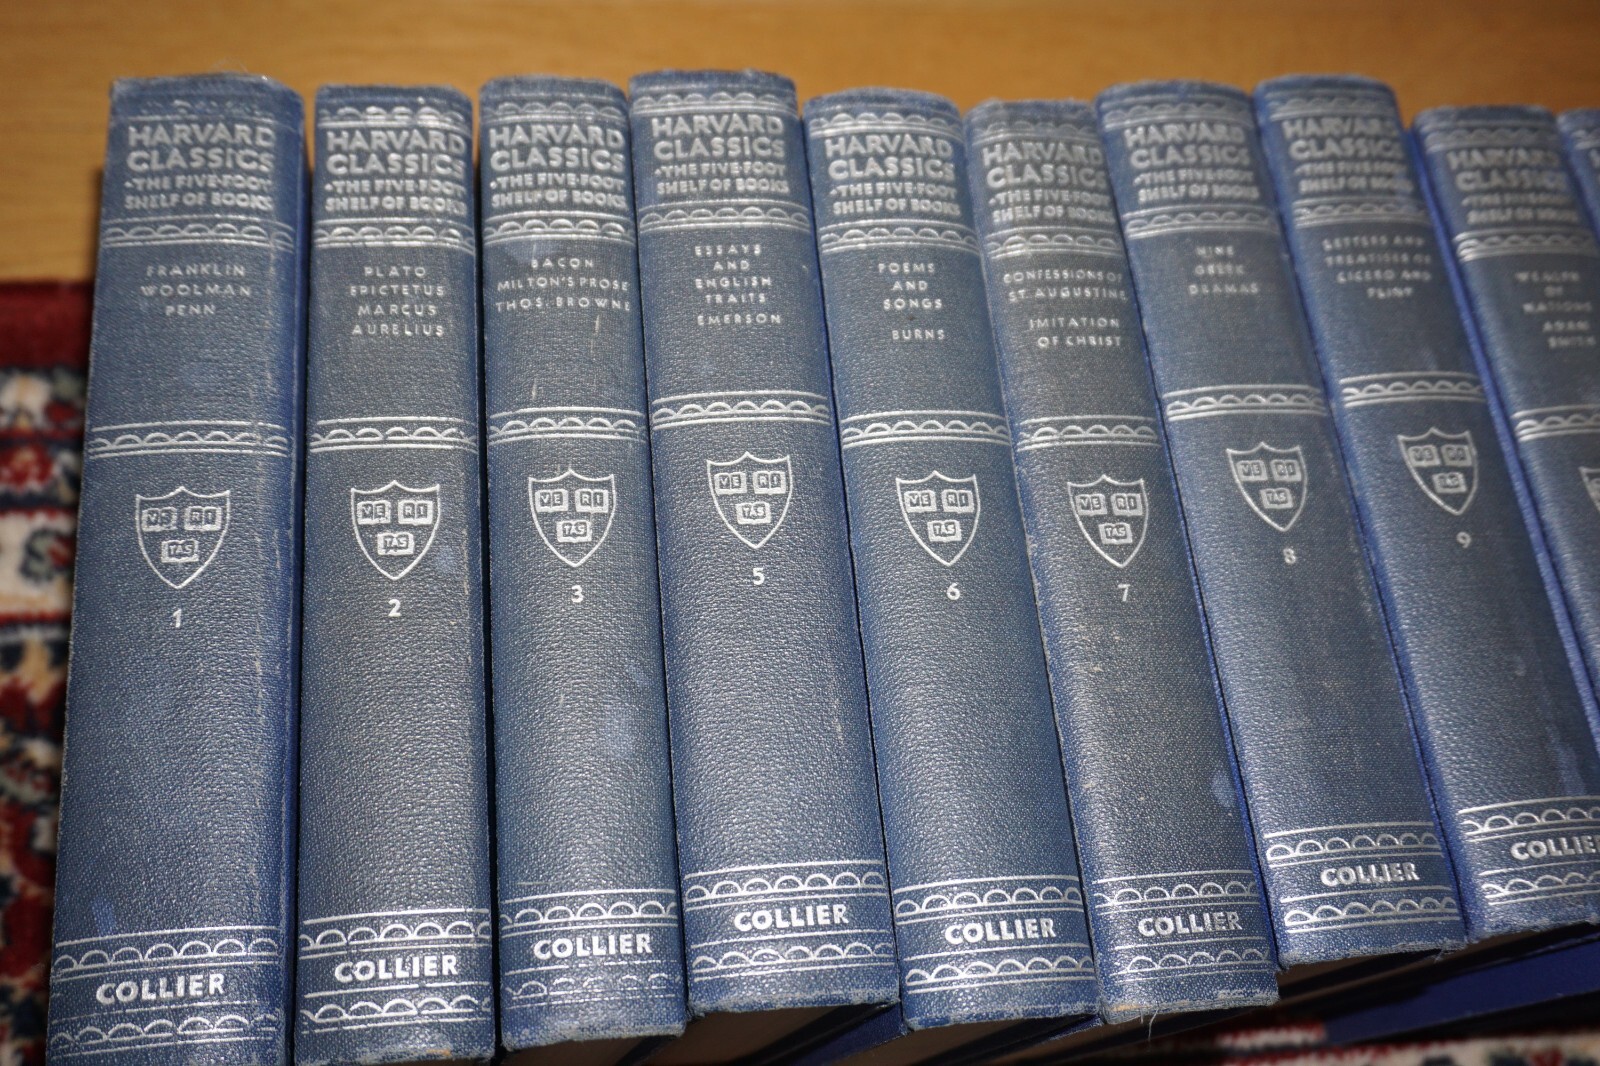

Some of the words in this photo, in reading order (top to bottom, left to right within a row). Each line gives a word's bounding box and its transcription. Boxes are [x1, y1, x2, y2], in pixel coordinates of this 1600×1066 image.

[651, 113, 784, 137] HARVARD
[128, 122, 275, 147] HARVARD
[326, 129, 466, 155] HARVARD
[489, 124, 624, 148] HARVARD
[1124, 121, 1245, 148] HARVARD
[654, 136, 786, 161] CLASSICS
[825, 134, 953, 158] HARVARD
[982, 142, 1104, 167] HARVARD
[126, 148, 274, 172] CLASSICS
[490, 147, 625, 173] CLASSICS
[1130, 146, 1250, 169] CLASSICS
[326, 153, 466, 180] CLASSICS
[661, 164, 697, 178] THE
[828, 157, 956, 181] CLASSICS
[132, 176, 171, 191] THE
[497, 173, 533, 188] THE
[986, 164, 1107, 189] CLASSICS
[332, 179, 371, 194] THE
[657, 179, 707, 195] SHELF
[710, 178, 731, 191] OF
[736, 177, 791, 194] BOOKS
[837, 183, 873, 197] THE
[124, 193, 179, 210] SHELF
[182, 192, 206, 206] OF
[211, 192, 274, 211] BOOKS
[325, 196, 379, 212] SHELF
[381, 195, 406, 210] OF
[409, 196, 467, 217] BOOKS
[491, 190, 542, 208] SHELF
[544, 189, 567, 203] OF
[571, 190, 628, 210] BOOKS
[833, 198, 882, 215] SHELF
[885, 198, 906, 211] OF
[910, 198, 961, 215] BOOKS
[695, 244, 761, 257] ESSAYS
[146, 263, 246, 277] FRANKLIN
[364, 265, 427, 279] PLATO
[531, 258, 594, 269] BACON
[713, 260, 750, 271] AND
[878, 263, 935, 273] POEMS
[497, 277, 574, 291] MILTON'S
[580, 277, 630, 291] PROSE
[695, 276, 772, 289] ENGLISH
[1004, 269, 1103, 283] CONFESSIONS
[1107, 273, 1122, 282] OF
[140, 284, 251, 297] WOOLMAN
[350, 285, 444, 297] EPICTETUS
[892, 281, 928, 291] AND
[1035, 287, 1126, 301] AUGUSTINE
[556, 297, 630, 311] BROWNE
[705, 293, 766, 304] TRAITS
[884, 299, 943, 310] SONGS
[165, 304, 216, 316] PENN
[357, 304, 437, 316] MARCUS
[697, 313, 782, 326] EMERSON
[1029, 317, 1120, 330] IMITATION
[352, 324, 444, 336] AURELIUS
[892, 330, 945, 340] BURNS
[1038, 336, 1058, 347] OF
[1066, 336, 1120, 346] CHRIST
[1456, 532, 1471, 548] 9
[1284, 548, 1296, 565] 8
[753, 568, 765, 585] 5
[571, 584, 584, 603] 3
[946, 583, 961, 601] 6
[1117, 584, 1131, 602] 7
[388, 599, 401, 617] 2
[172, 609, 182, 627] 1
[1510, 835, 1600, 860] COLLIE
[1321, 862, 1420, 887] COLLIER
[734, 904, 849, 932] COLLIER
[1138, 912, 1243, 938] COLLIER
[945, 918, 1056, 945] COLLIER
[533, 933, 653, 961] COLLIER
[334, 954, 458, 983] COLLIER
[96, 973, 226, 1004] COLLIER
